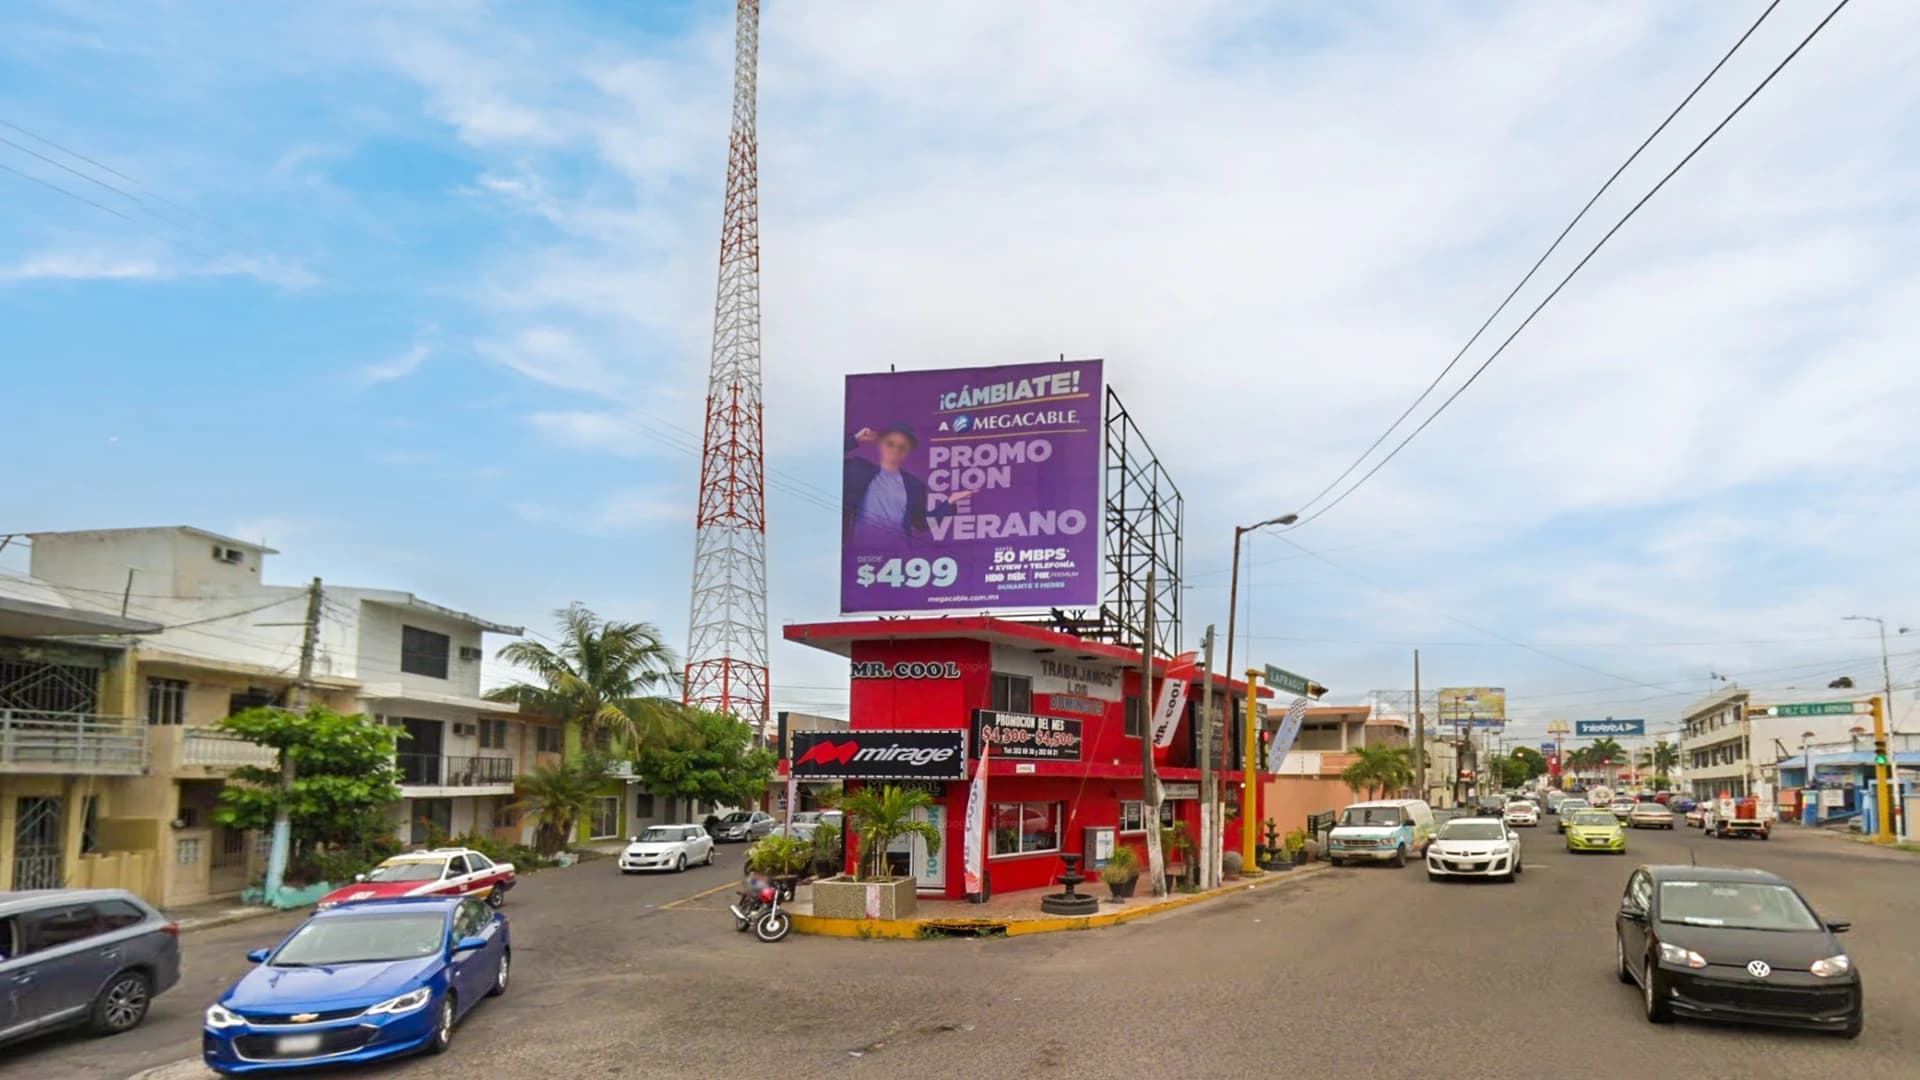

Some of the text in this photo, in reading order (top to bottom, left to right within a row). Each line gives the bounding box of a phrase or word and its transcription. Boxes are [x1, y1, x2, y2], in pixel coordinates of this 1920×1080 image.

[940, 371, 1080, 411] ¡CÁMBIATE!
[938, 410, 1078, 431] A MEGACABLE
[928, 439, 1053, 468] PROMO
[926, 509, 1087, 541] VERANO
[994, 551, 1015, 563] 50
[1030, 560, 1075, 569] TELEFONÍA
[856, 557, 958, 588] $499
[928, 594, 999, 603] megacable.com.mx
[850, 661, 961, 679] MR. COOL
[1040, 659, 1112, 687] TRABAJAMOS
[1067, 681, 1088, 696] LOS
[996, 714, 1065, 731] PROMOCION DEL MES
[1153, 680, 1182, 745] MR. COOL
[852, 744, 954, 766] mirage
